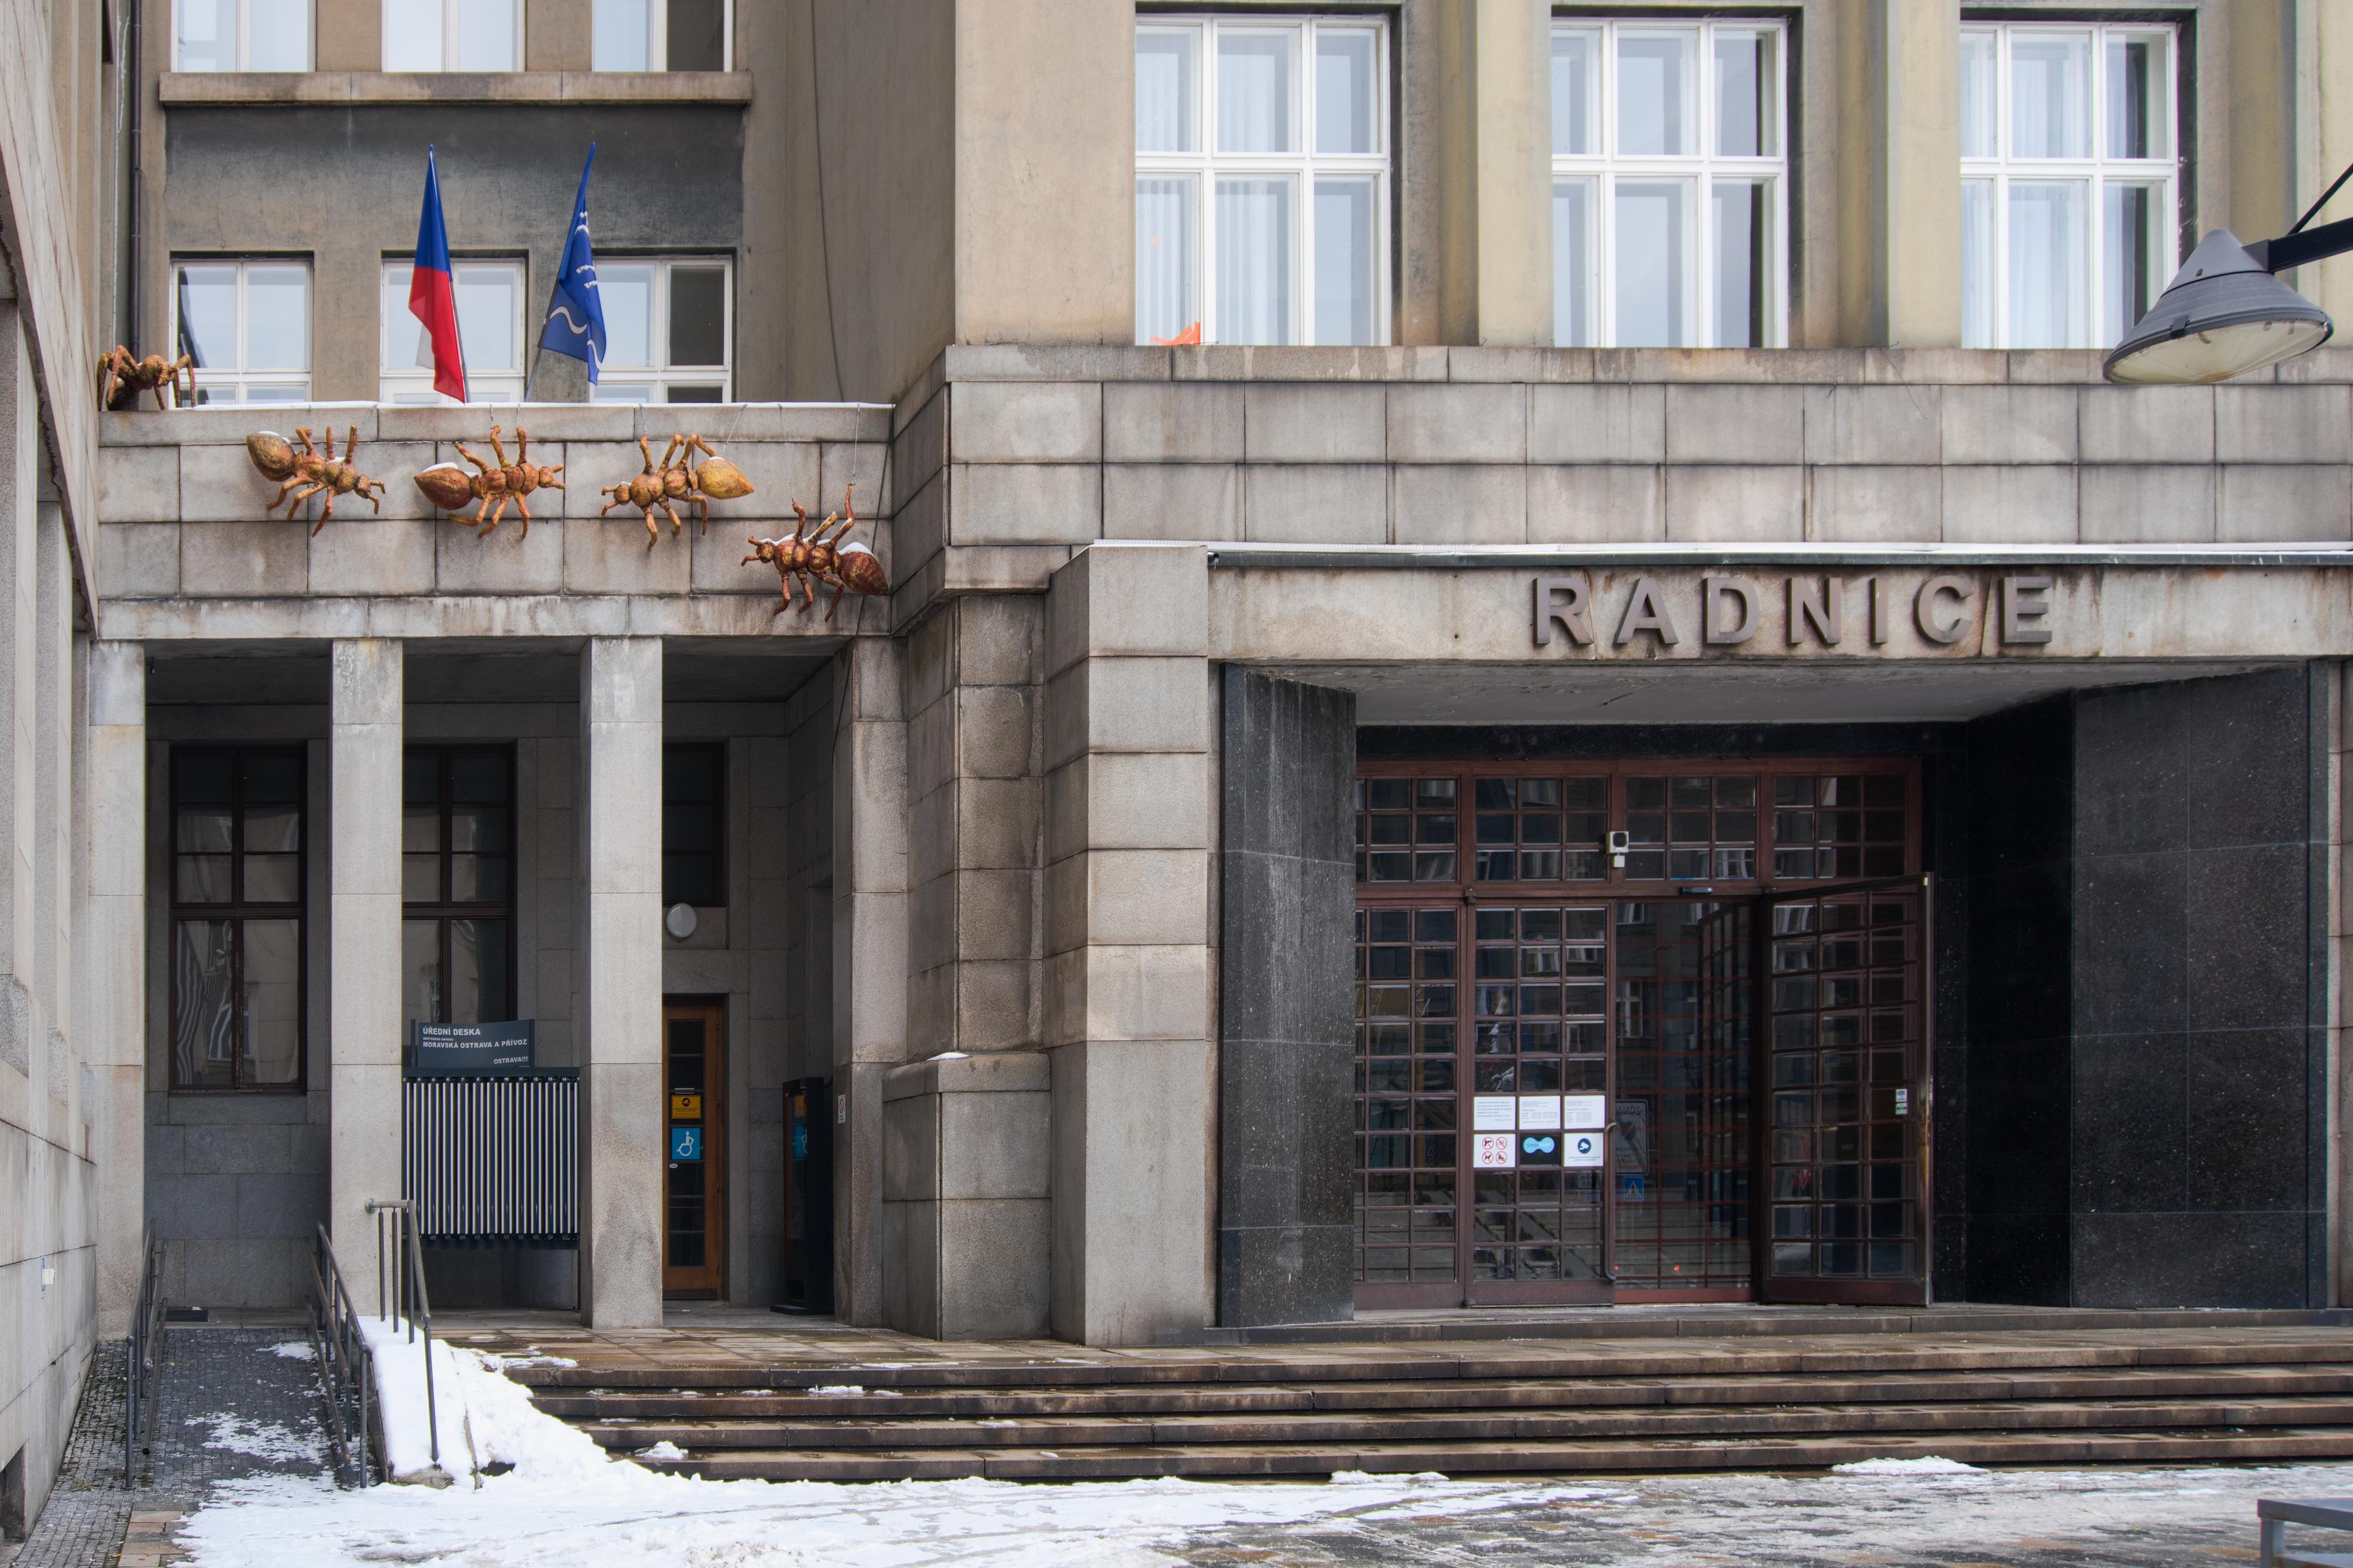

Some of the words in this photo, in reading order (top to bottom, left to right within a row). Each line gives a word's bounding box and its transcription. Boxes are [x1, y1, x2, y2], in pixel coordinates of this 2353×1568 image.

[1532, 576, 2053, 646] RADNICE
[423, 1026, 451, 1035] ÚŘEDNÍ
[501, 1039, 527, 1047] PŘÍVOZ
[494, 1056, 528, 1064] OSTRAVA!!!
